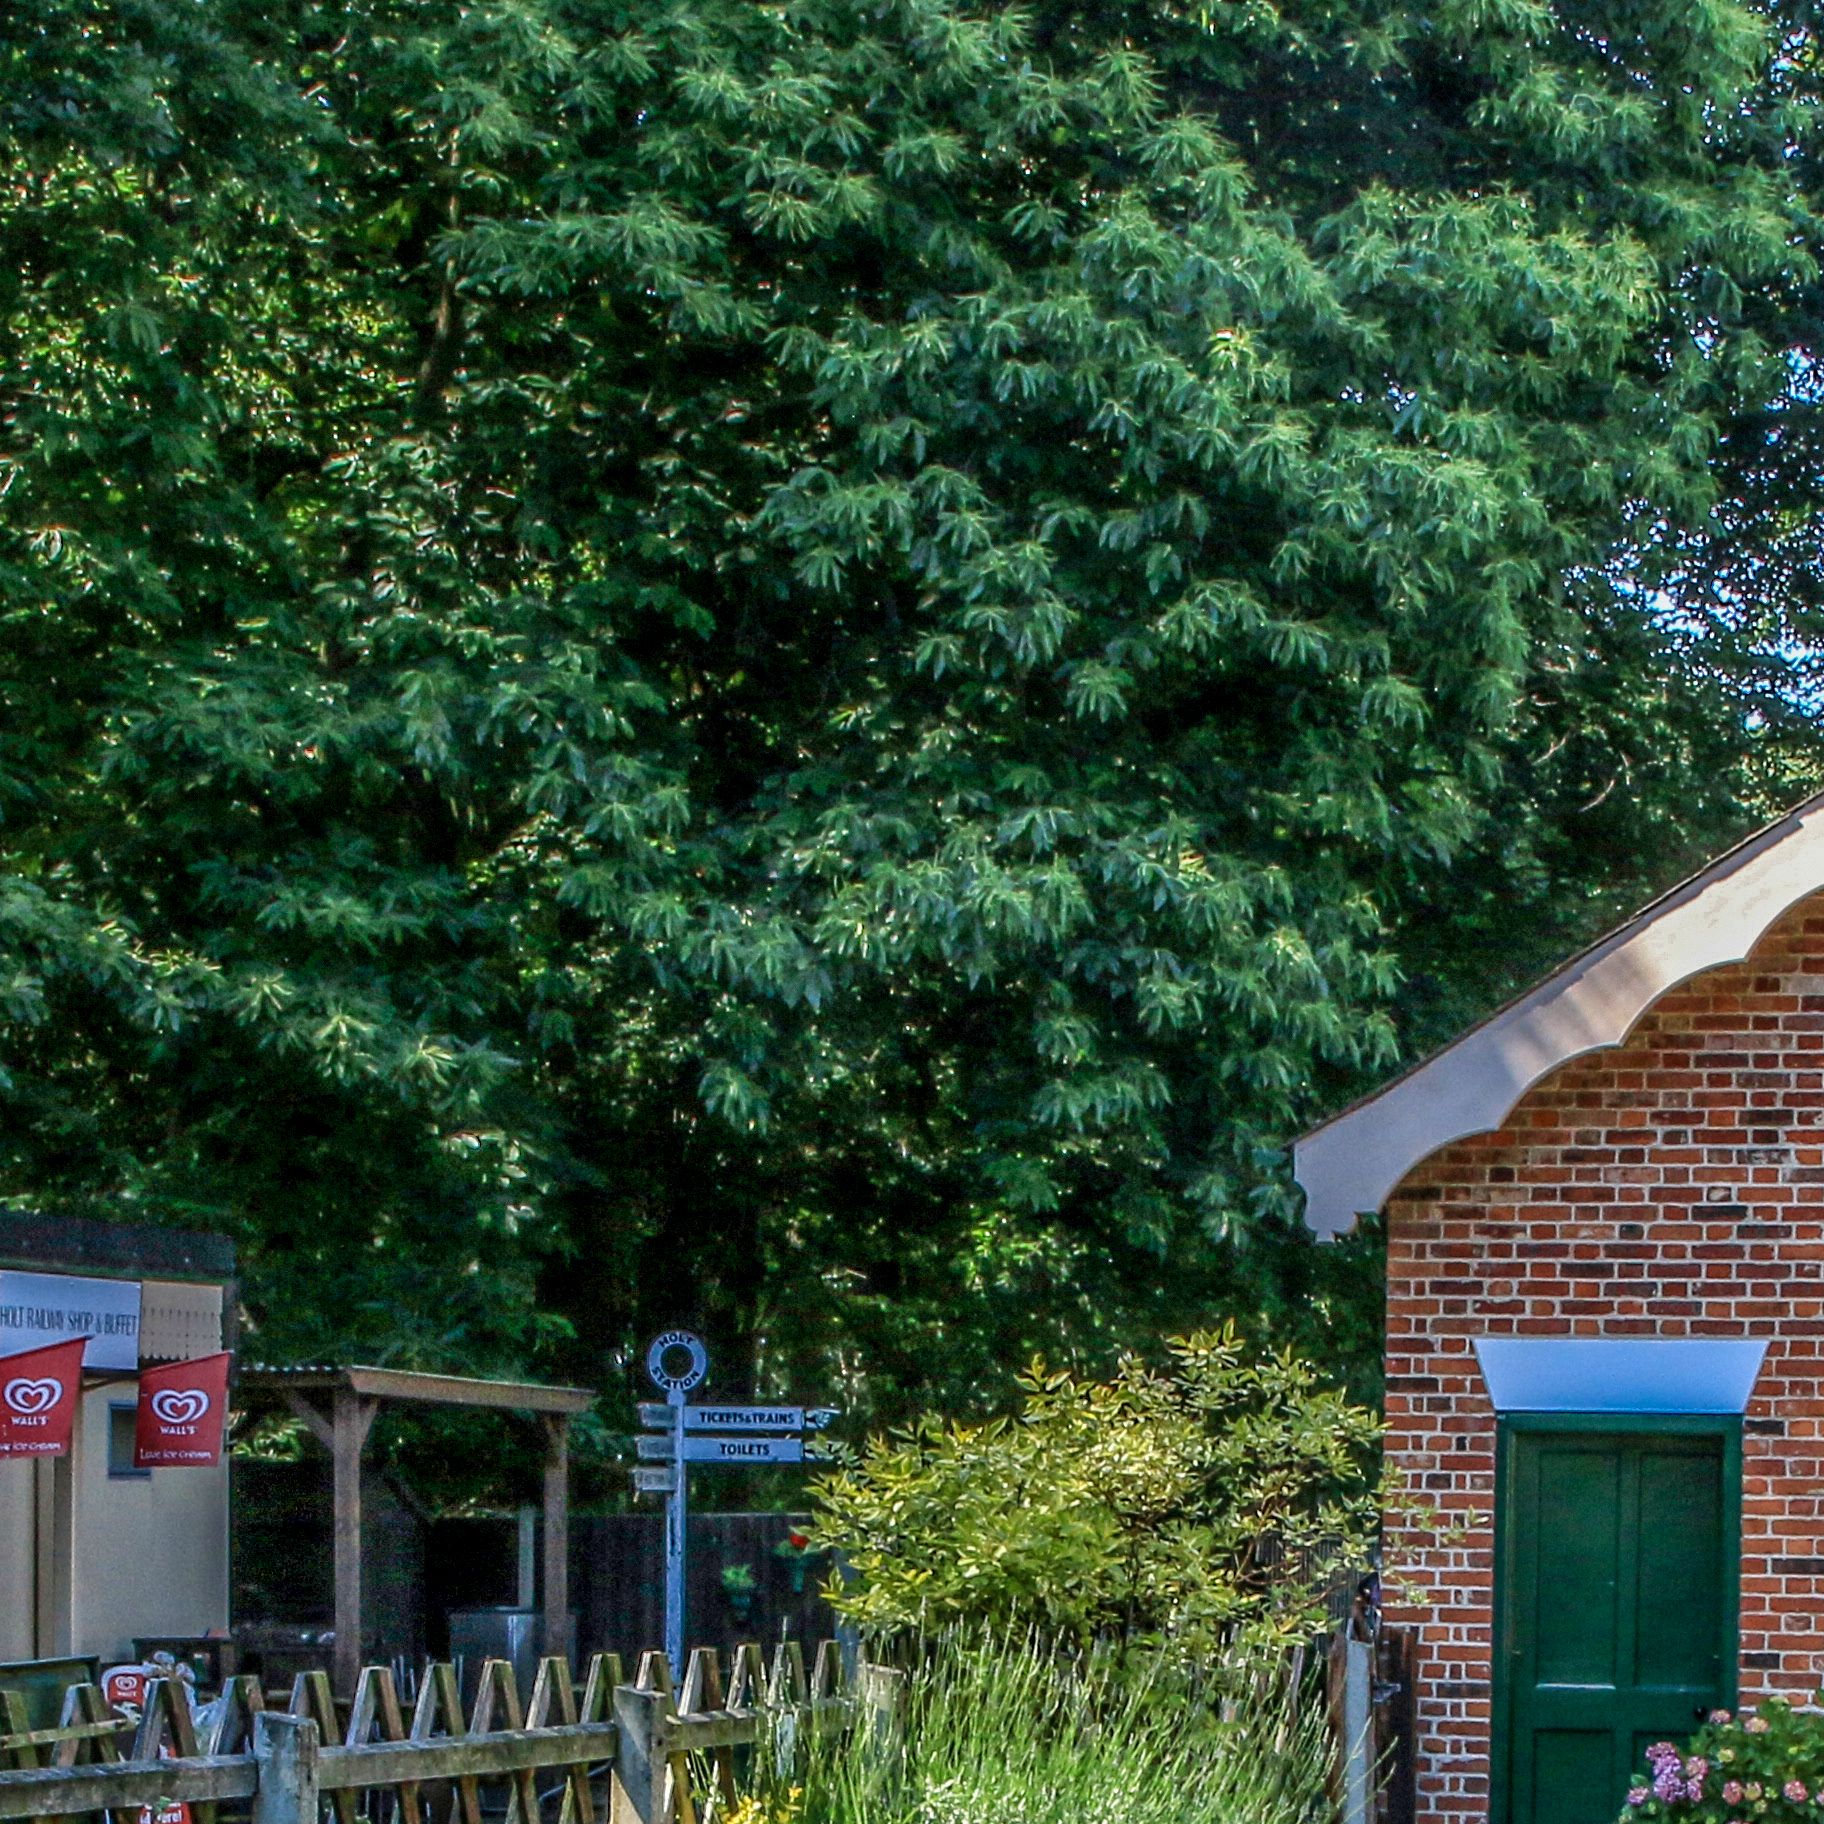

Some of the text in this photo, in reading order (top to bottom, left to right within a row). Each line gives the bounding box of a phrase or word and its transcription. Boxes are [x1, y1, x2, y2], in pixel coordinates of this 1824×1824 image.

[0, 1306, 137, 1336] HOLT RAILWAY SHOP & BUFFET
[659, 1333, 694, 1348] HOLT
[652, 1366, 700, 1389] STATION
[11, 1415, 47, 1425] WALL'S
[159, 1425, 195, 1436] WALL'S
[720, 1444, 770, 1456] TOILETS
